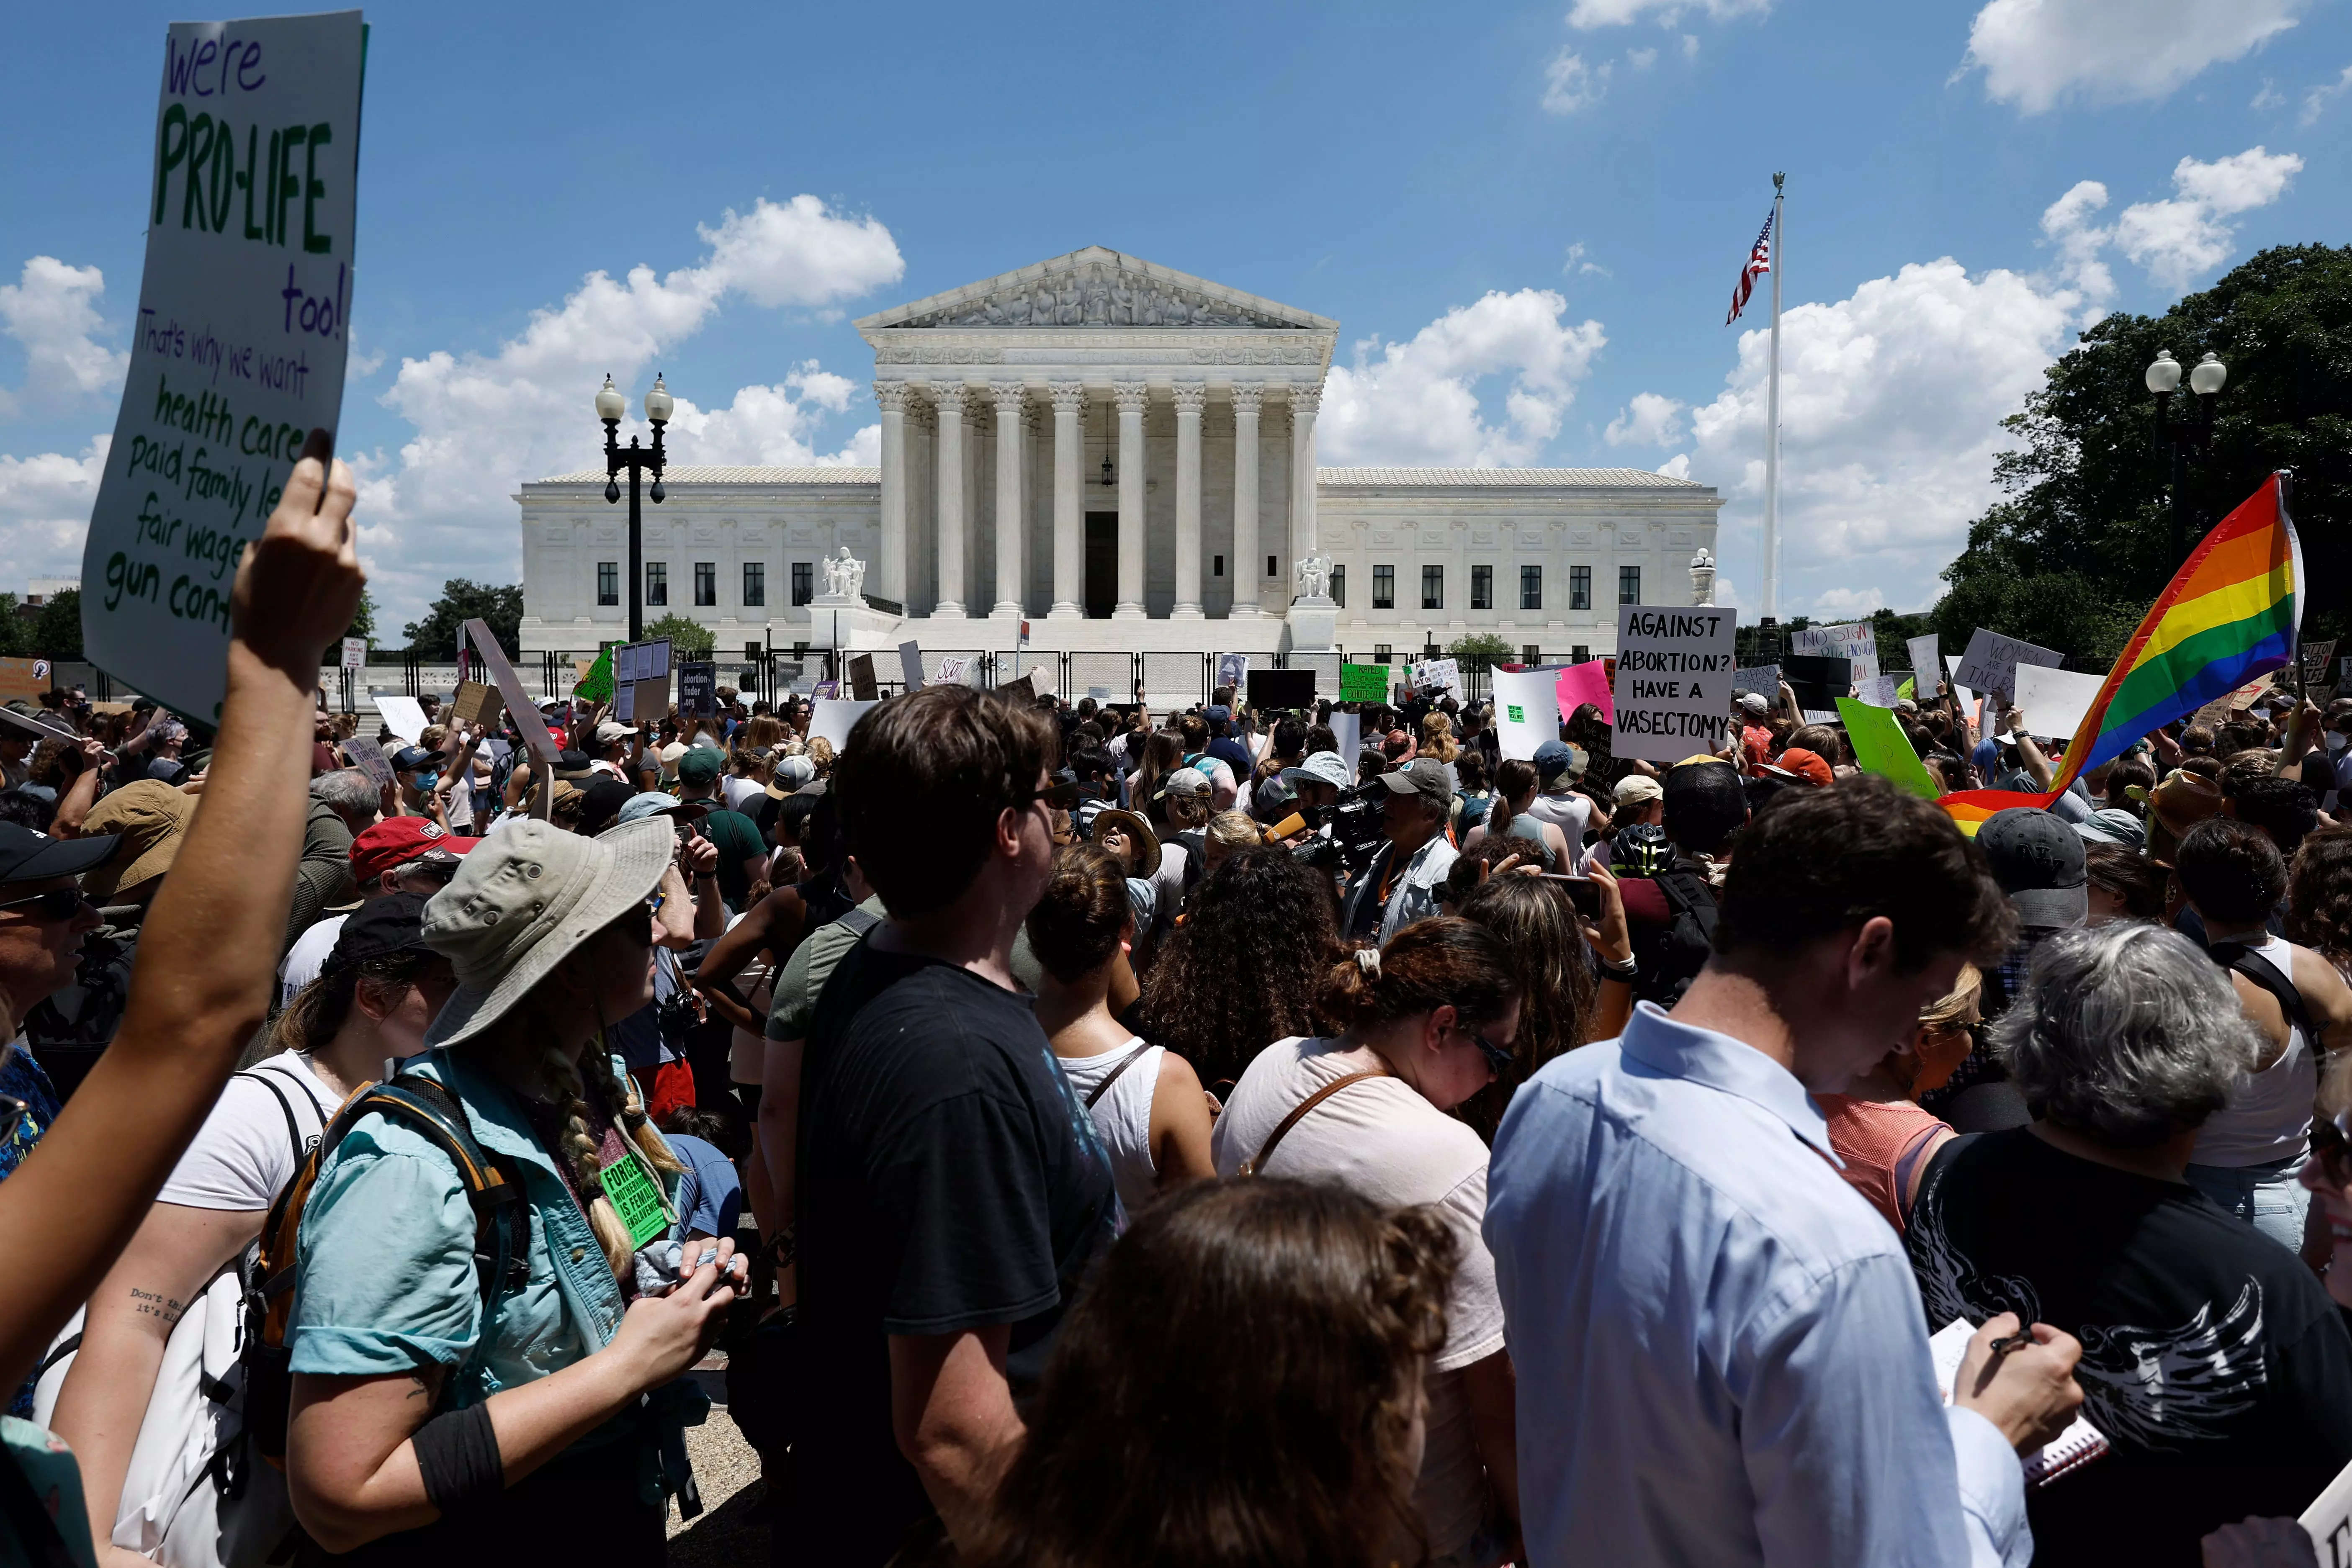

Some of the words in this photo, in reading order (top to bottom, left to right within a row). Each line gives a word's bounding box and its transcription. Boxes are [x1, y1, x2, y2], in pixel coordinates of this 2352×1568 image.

[168, 31, 266, 97] We're
[155, 102, 332, 254] PRO-LIFE
[281, 262, 345, 341] too!
[141, 308, 185, 358] That's
[192, 323, 224, 386] why
[229, 343, 252, 379] we
[259, 350, 309, 401] want
[154, 373, 232, 447] health
[128, 435, 184, 486] paid
[185, 447, 252, 529] family
[137, 491, 182, 547] fair
[186, 523, 248, 581] wage
[104, 551, 160, 612] gun
[170, 574, 231, 635] cont
[1628, 613, 1721, 638] AGAINST
[1803, 630, 1827, 648] NO
[1834, 623, 1867, 642] SIGN
[1618, 650, 1730, 672] ABORTION?
[1846, 640, 1876, 658] ENOUGH
[1990, 637, 2045, 666] WOMEN
[1415, 661, 1426, 670] MY
[1735, 666, 1777, 682] EXPAND
[1853, 664, 1869, 680] ALL
[1984, 661, 2002, 670] ARE
[2006, 665, 2016, 675] NO
[2270, 668, 2296, 683] MY
[2305, 666, 2326, 683] IFE
[684, 673, 708, 684] abortion
[684, 685, 700, 696] finder
[1414, 678, 1424, 686] MY
[1632, 679, 1679, 699] HAVE
[1688, 683, 1703, 698] A
[1745, 677, 1769, 688] THIS
[1966, 666, 2016, 695] INCUBA
[684, 699, 695, 708] .org
[1616, 709, 1729, 740] VASECTOMY
[345, 739, 364, 752] OUR
[604, 1154, 641, 1191] FORCE
[613, 1175, 648, 1204] MOTHERHOO
[620, 1202, 631, 1218] IS
[629, 1182, 659, 1211] FEMAL
[625, 1200, 660, 1230] ENSLAVEME
[130, 1288, 162, 1303] Don't
[167, 1299, 185, 1311] thi
[136, 1303, 161, 1316] it's
